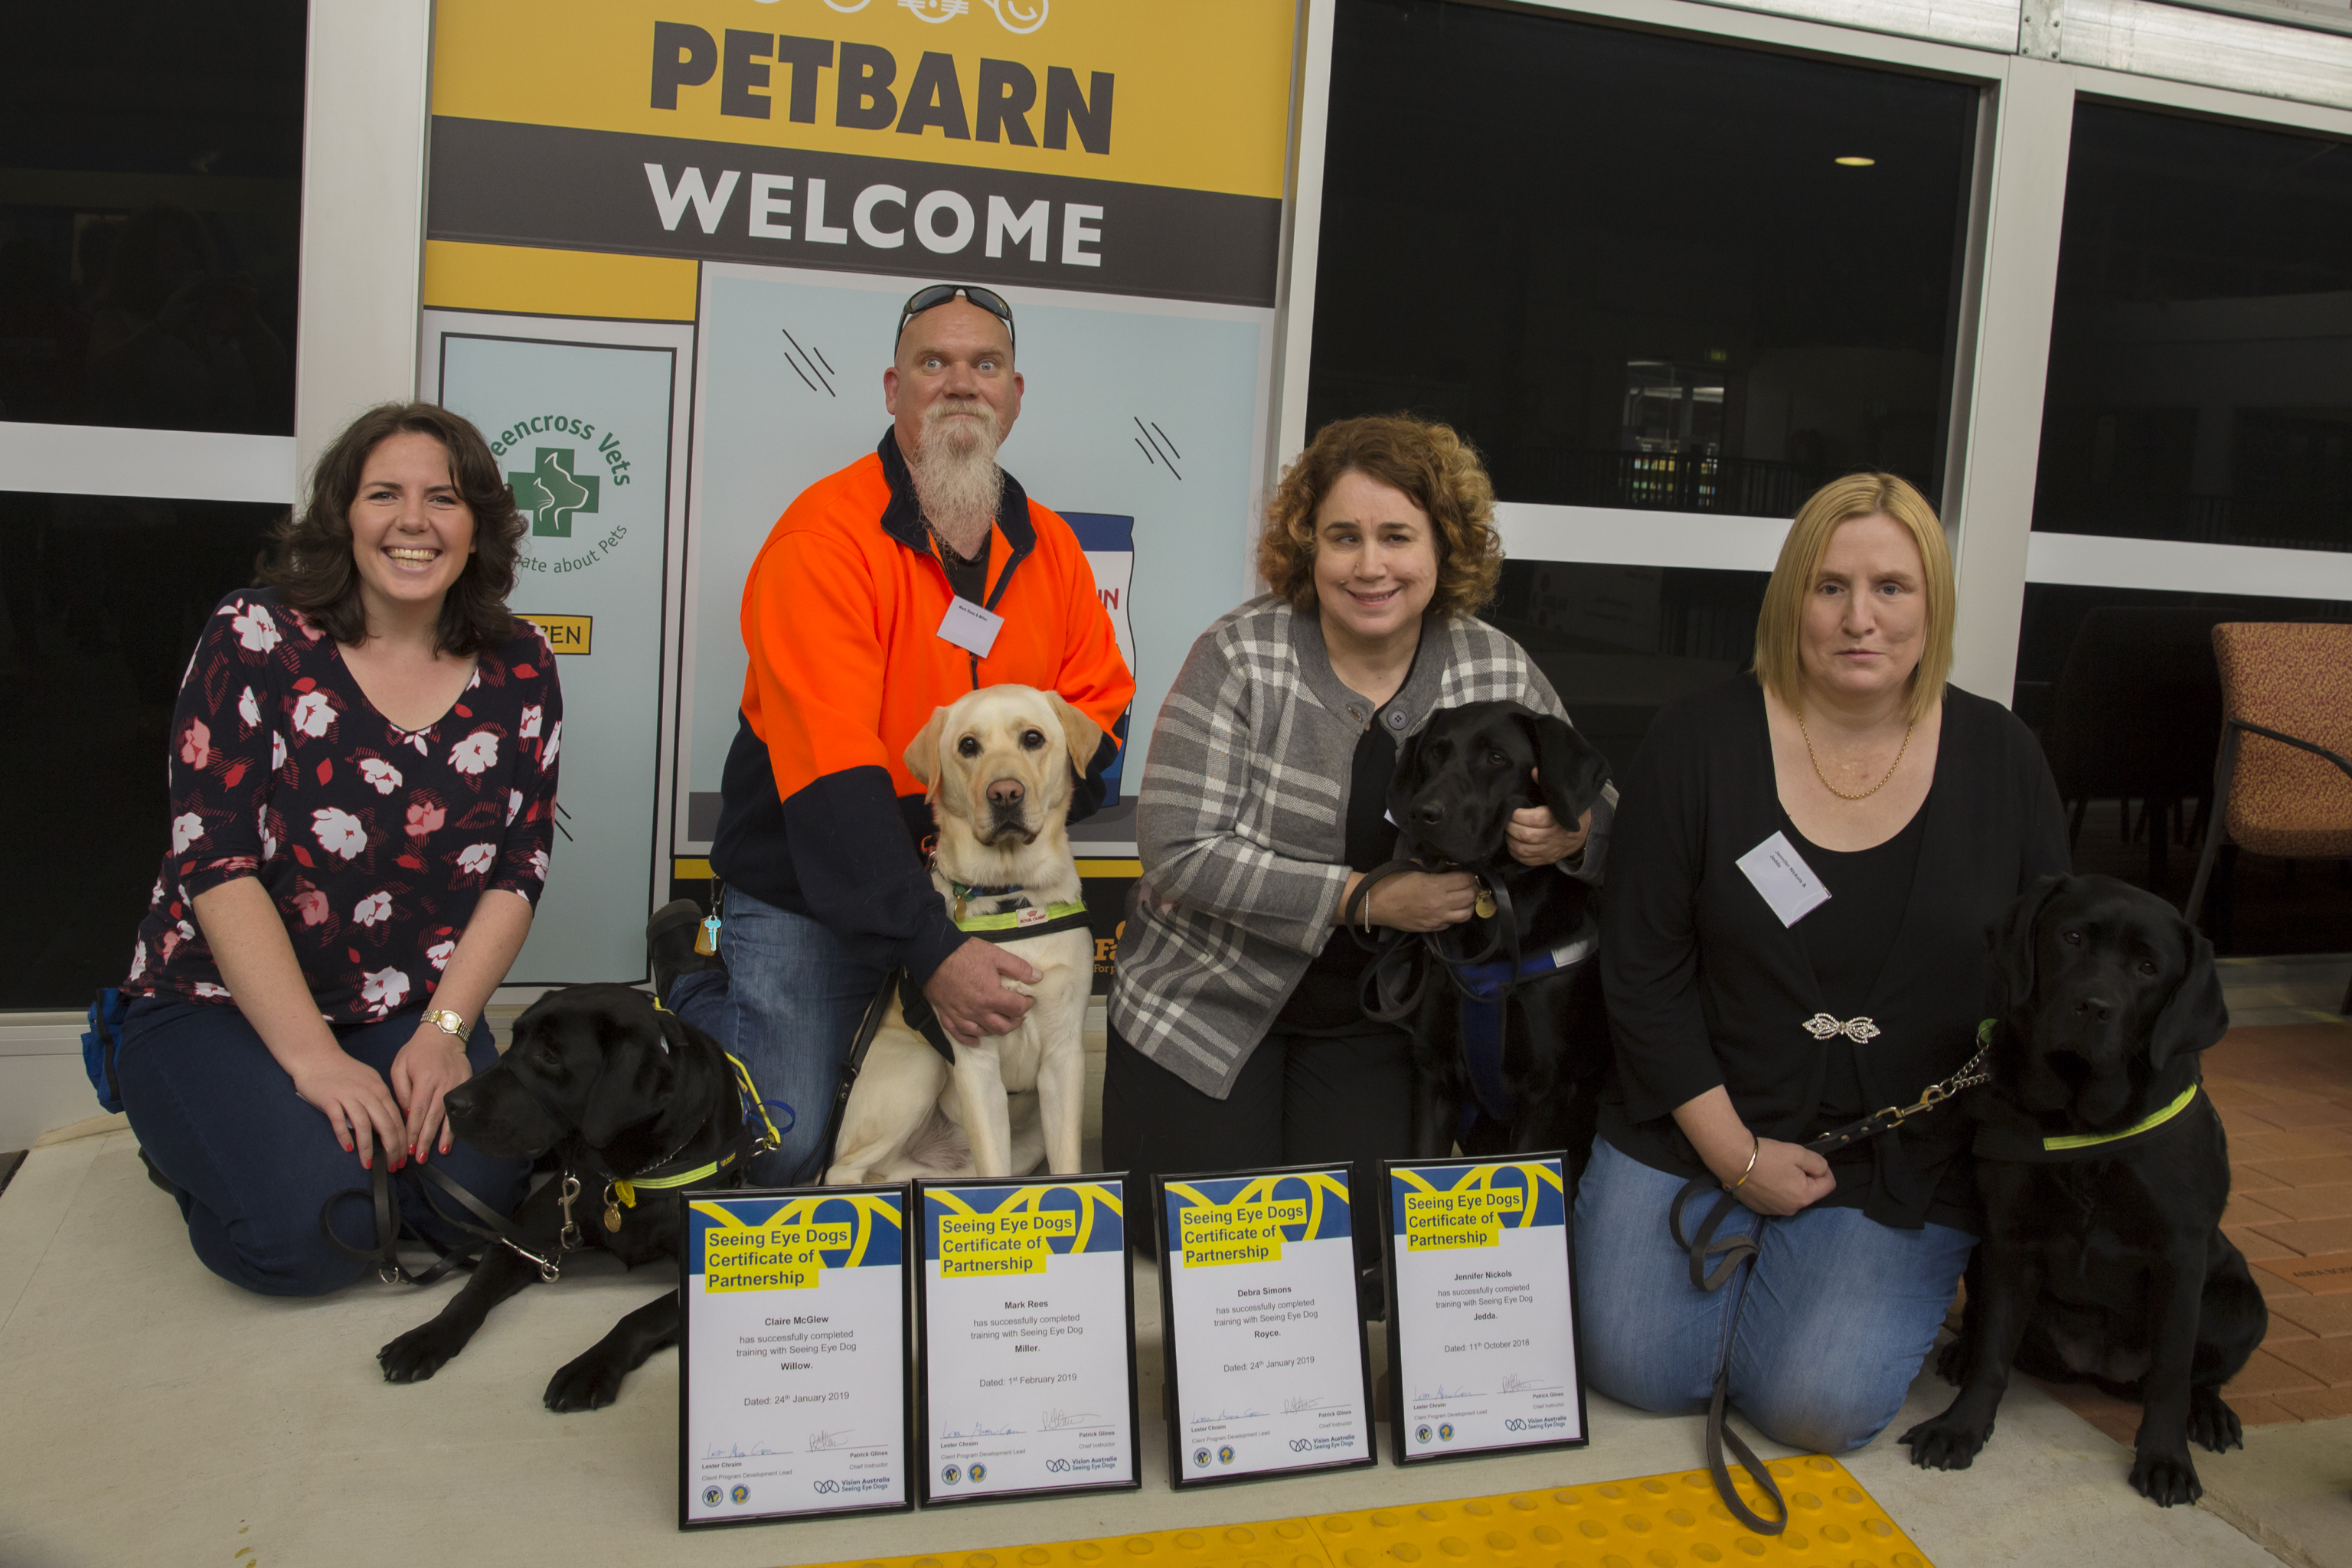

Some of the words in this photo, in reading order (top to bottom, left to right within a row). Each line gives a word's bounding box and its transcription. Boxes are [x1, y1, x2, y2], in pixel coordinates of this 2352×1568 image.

[650, 20, 1115, 155] PETBARN
[643, 162, 1103, 266] WELCOME
[490, 415, 596, 456] eencross
[598, 432, 631, 486] Vets
[554, 550, 600, 573] about
[598, 525, 627, 554] Pets
[1775, 851, 1790, 867] Jennifer
[1094, 939, 1118, 961] Fa
[1094, 964, 1109, 973] For
[1408, 1197, 1454, 1211] Seeing
[1458, 1194, 1482, 1210] Eye
[1486, 1193, 1521, 1207] Dogs
[1184, 1210, 1233, 1226] Seeing
[1236, 1208, 1263, 1224] Eye
[1267, 1206, 1304, 1220] Dogs
[1409, 1214, 1477, 1229] Certificate
[1481, 1211, 1494, 1224] of
[942, 1219, 995, 1235] Seeing
[1000, 1217, 1028, 1234] Eye
[1033, 1217, 1073, 1233] Dogs
[1184, 1227, 1258, 1244] Certificate
[1262, 1224, 1276, 1238] of
[709, 1232, 765, 1249] Seeing
[771, 1230, 801, 1247] Eye
[806, 1229, 848, 1245] Dogs
[942, 1238, 1022, 1253] Certificate
[1026, 1235, 1042, 1250] of
[1410, 1230, 1488, 1247] Partnership
[708, 1251, 793, 1268] Certificate
[798, 1249, 815, 1263] of
[1185, 1244, 1269, 1263] Partnership
[943, 1256, 1033, 1273] Partnership
[709, 1270, 805, 1288] Partnership
[1454, 1272, 1484, 1282] Jennifer
[1485, 1270, 1513, 1279] Nickols
[1237, 1289, 1261, 1298] Debra
[1263, 1286, 1292, 1295] Simons
[1452, 1286, 1494, 1296] successfully
[1494, 1283, 1530, 1294] completed
[1004, 1301, 1026, 1309] Mark
[1027, 1300, 1049, 1308] Rees
[1231, 1302, 1276, 1314] successfully
[1277, 1298, 1315, 1309] completed
[1436, 1301, 1462, 1309] training
[1462, 1298, 1477, 1307] with
[1478, 1298, 1503, 1306] Seeing
[1504, 1295, 1517, 1305] Eye
[1518, 1295, 1534, 1304] Dog
[764, 1318, 791, 1327] Claire
[793, 1315, 829, 1325] McGlew
[973, 1319, 988, 1328] has
[990, 1316, 1038, 1327] successfully
[1039, 1313, 1080, 1325] completed
[1214, 1318, 1242, 1327] training
[1243, 1315, 1259, 1325] with
[1259, 1314, 1285, 1323] Seeing
[1287, 1312, 1302, 1321] Eye
[1302, 1310, 1318, 1320] Dog
[1473, 1312, 1498, 1321] Jedda.
[739, 1336, 756, 1344] has
[757, 1332, 808, 1344] successfully
[810, 1330, 854, 1341] completed
[970, 1331, 1000, 1341] training
[1001, 1329, 1018, 1338] with
[1020, 1328, 1048, 1338] Seeing
[1050, 1327, 1066, 1337] Eye
[1067, 1325, 1083, 1335] Dog
[1254, 1330, 1281, 1340] Royce.
[736, 1349, 768, 1357] training
[769, 1346, 787, 1355] with
[789, 1345, 818, 1355] Seeing
[821, 1343, 838, 1354] Eye
[839, 1342, 857, 1353] Dog
[1014, 1344, 1040, 1353] Miller.
[1444, 1344, 1467, 1353] Dated:
[1483, 1341, 1511, 1350] October
[1512, 1338, 1530, 1348] 2018
[780, 1362, 813, 1371] Willow.
[1223, 1363, 1248, 1373] Dated:
[1266, 1359, 1295, 1369] January
[1296, 1355, 1315, 1366] 2019
[979, 1377, 1005, 1388] Dated:
[1019, 1376, 1056, 1385] February
[1057, 1373, 1077, 1383] 2019
[743, 1396, 772, 1406] Dated:
[792, 1394, 827, 1403] January
[828, 1391, 850, 1401] 2019
[1544, 1415, 1567, 1423] Australia
[1330, 1434, 1355, 1444] Australia
[1090, 1455, 1118, 1465] Australia
[861, 1477, 890, 1485] Australia
